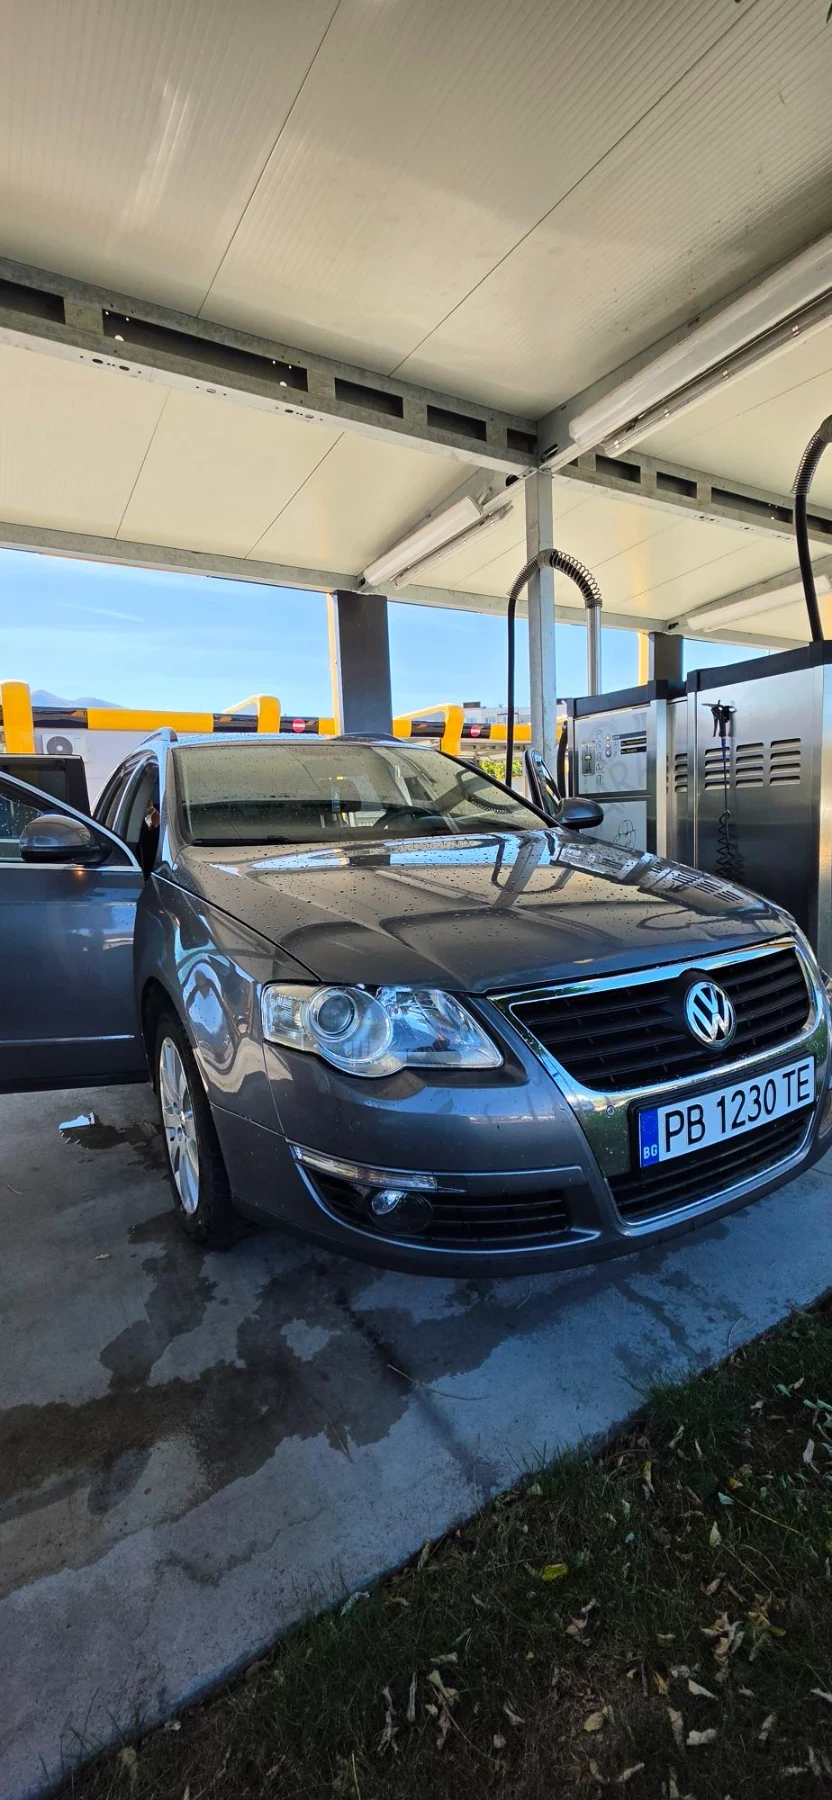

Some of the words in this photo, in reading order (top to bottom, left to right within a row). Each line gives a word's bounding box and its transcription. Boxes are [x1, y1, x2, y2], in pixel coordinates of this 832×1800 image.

[688, 982, 733, 1045] VW
[665, 1104, 706, 1153] PB
[716, 1078, 777, 1134] 1230
[782, 1064, 810, 1107] TE
[643, 1144, 658, 1160] BG
